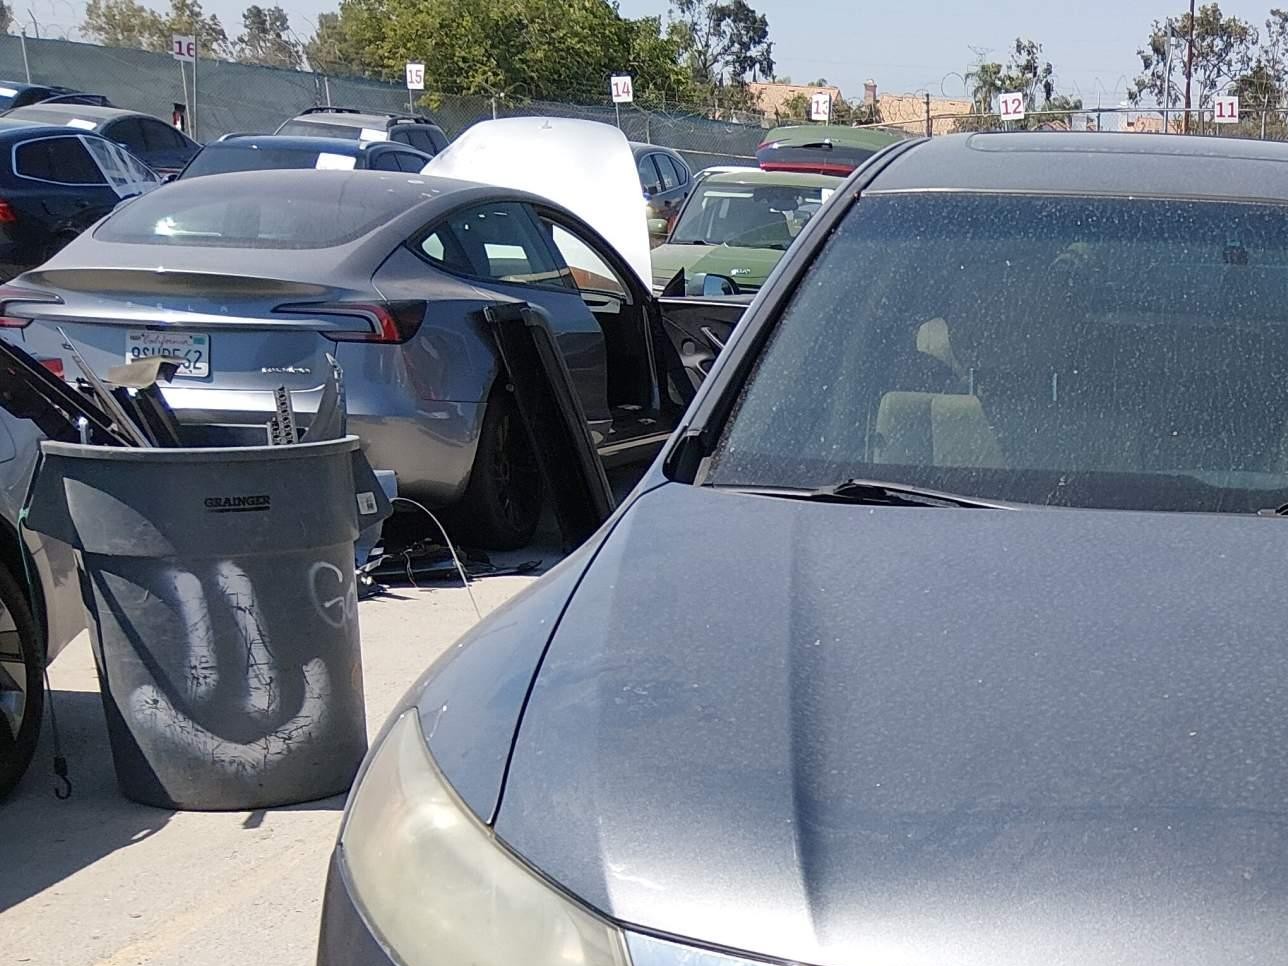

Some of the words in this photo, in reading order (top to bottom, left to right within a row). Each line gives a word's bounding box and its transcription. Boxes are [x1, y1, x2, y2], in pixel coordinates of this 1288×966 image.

[408, 69, 422, 85] 15
[612, 81, 631, 98] 14
[1001, 97, 1022, 116] 12
[1215, 101, 1237, 118] 11
[204, 494, 272, 508] GRAINGER
